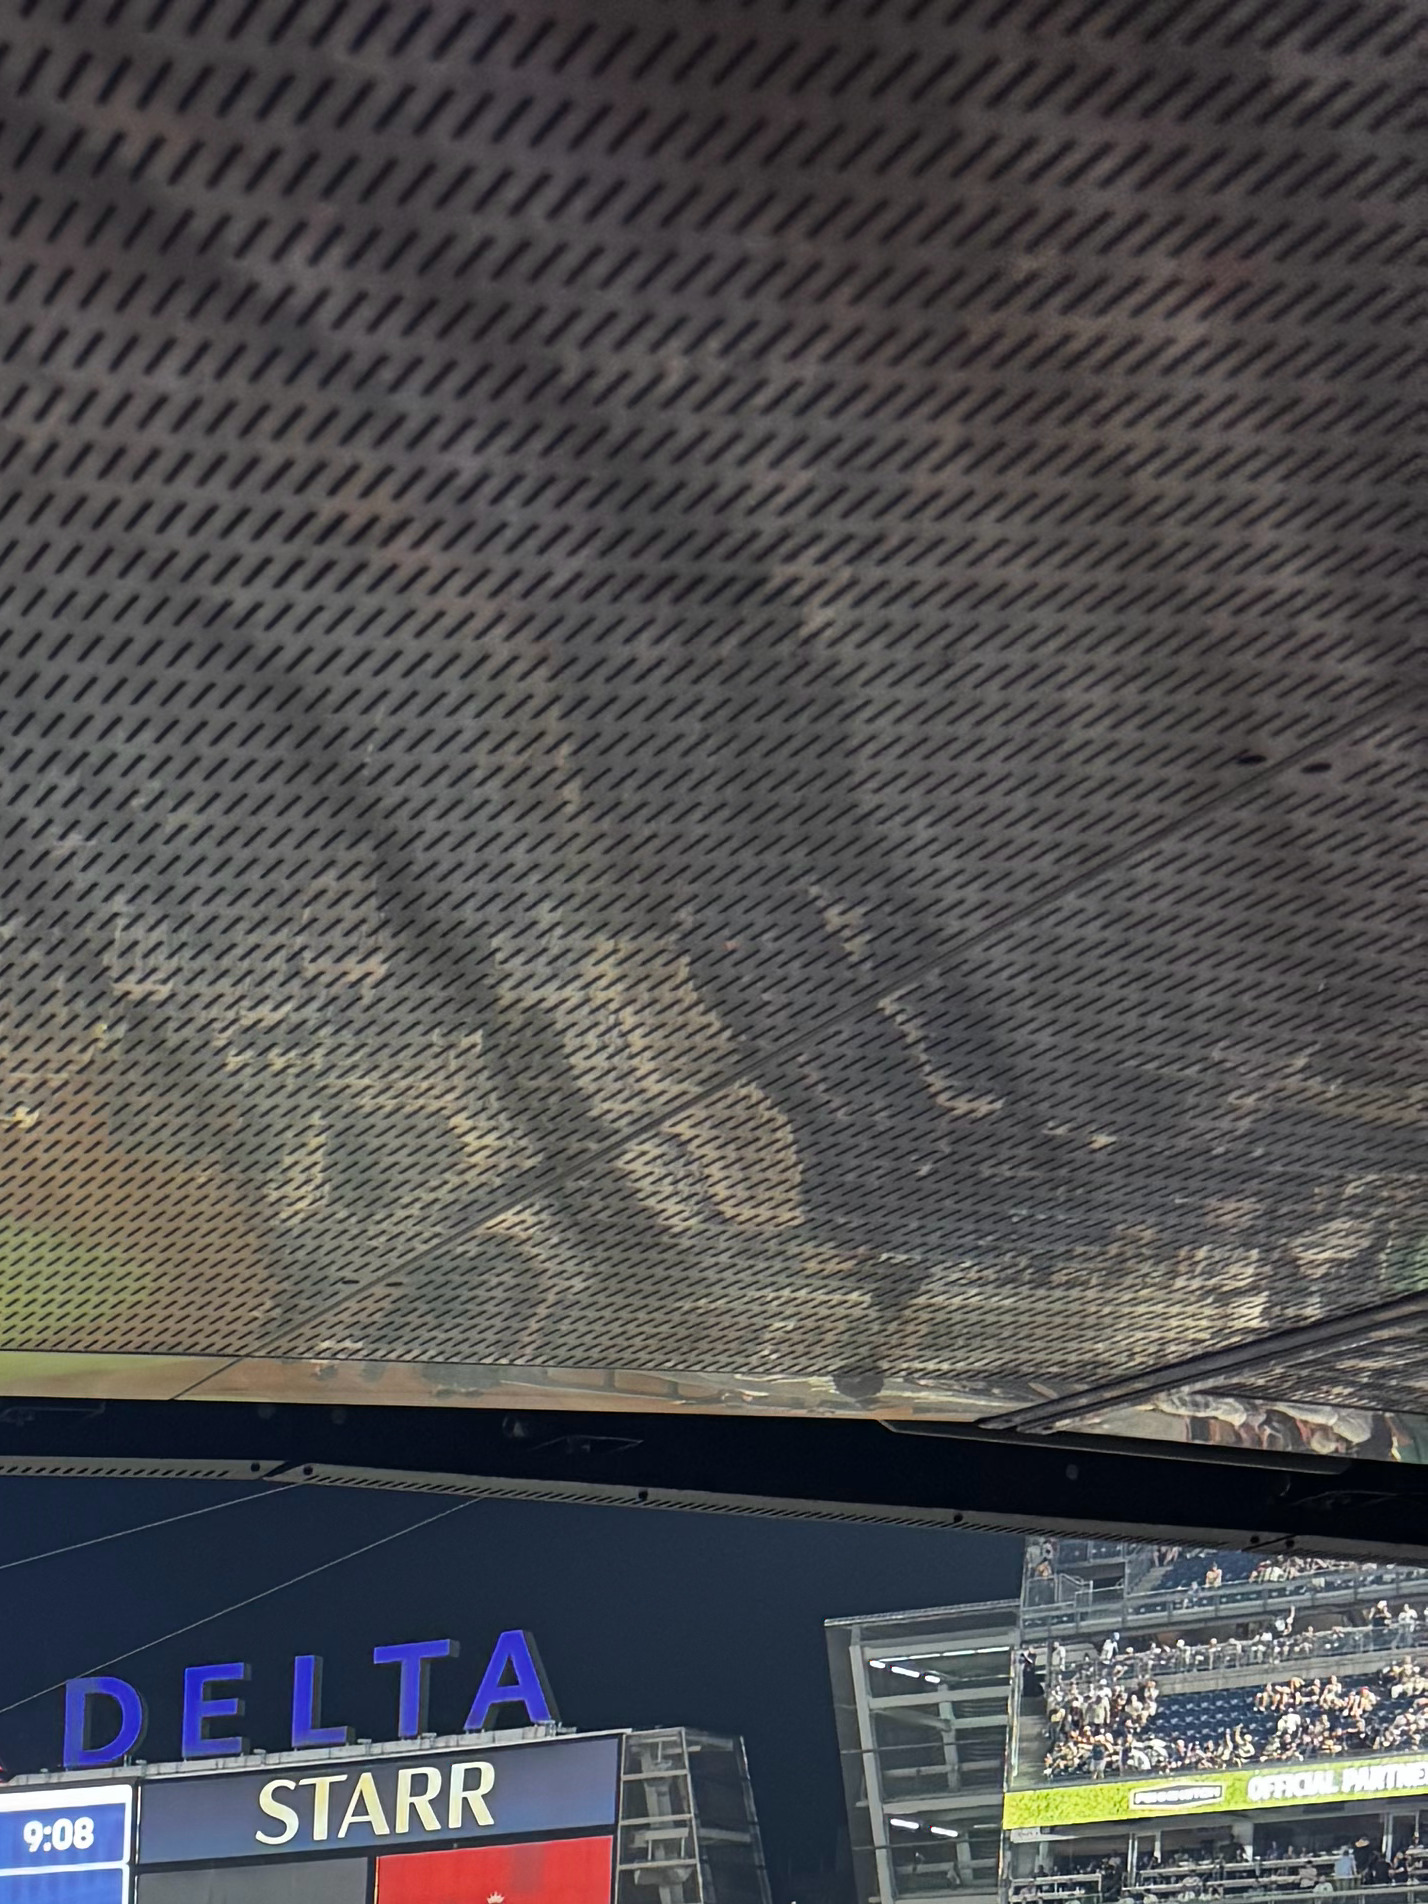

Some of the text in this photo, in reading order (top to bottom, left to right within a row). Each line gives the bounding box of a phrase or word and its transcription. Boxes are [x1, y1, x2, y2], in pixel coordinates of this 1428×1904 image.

[64, 1630, 553, 1767] DELTA
[23, 1817, 95, 1853] 9:08
[255, 1760, 496, 1846] STARR
